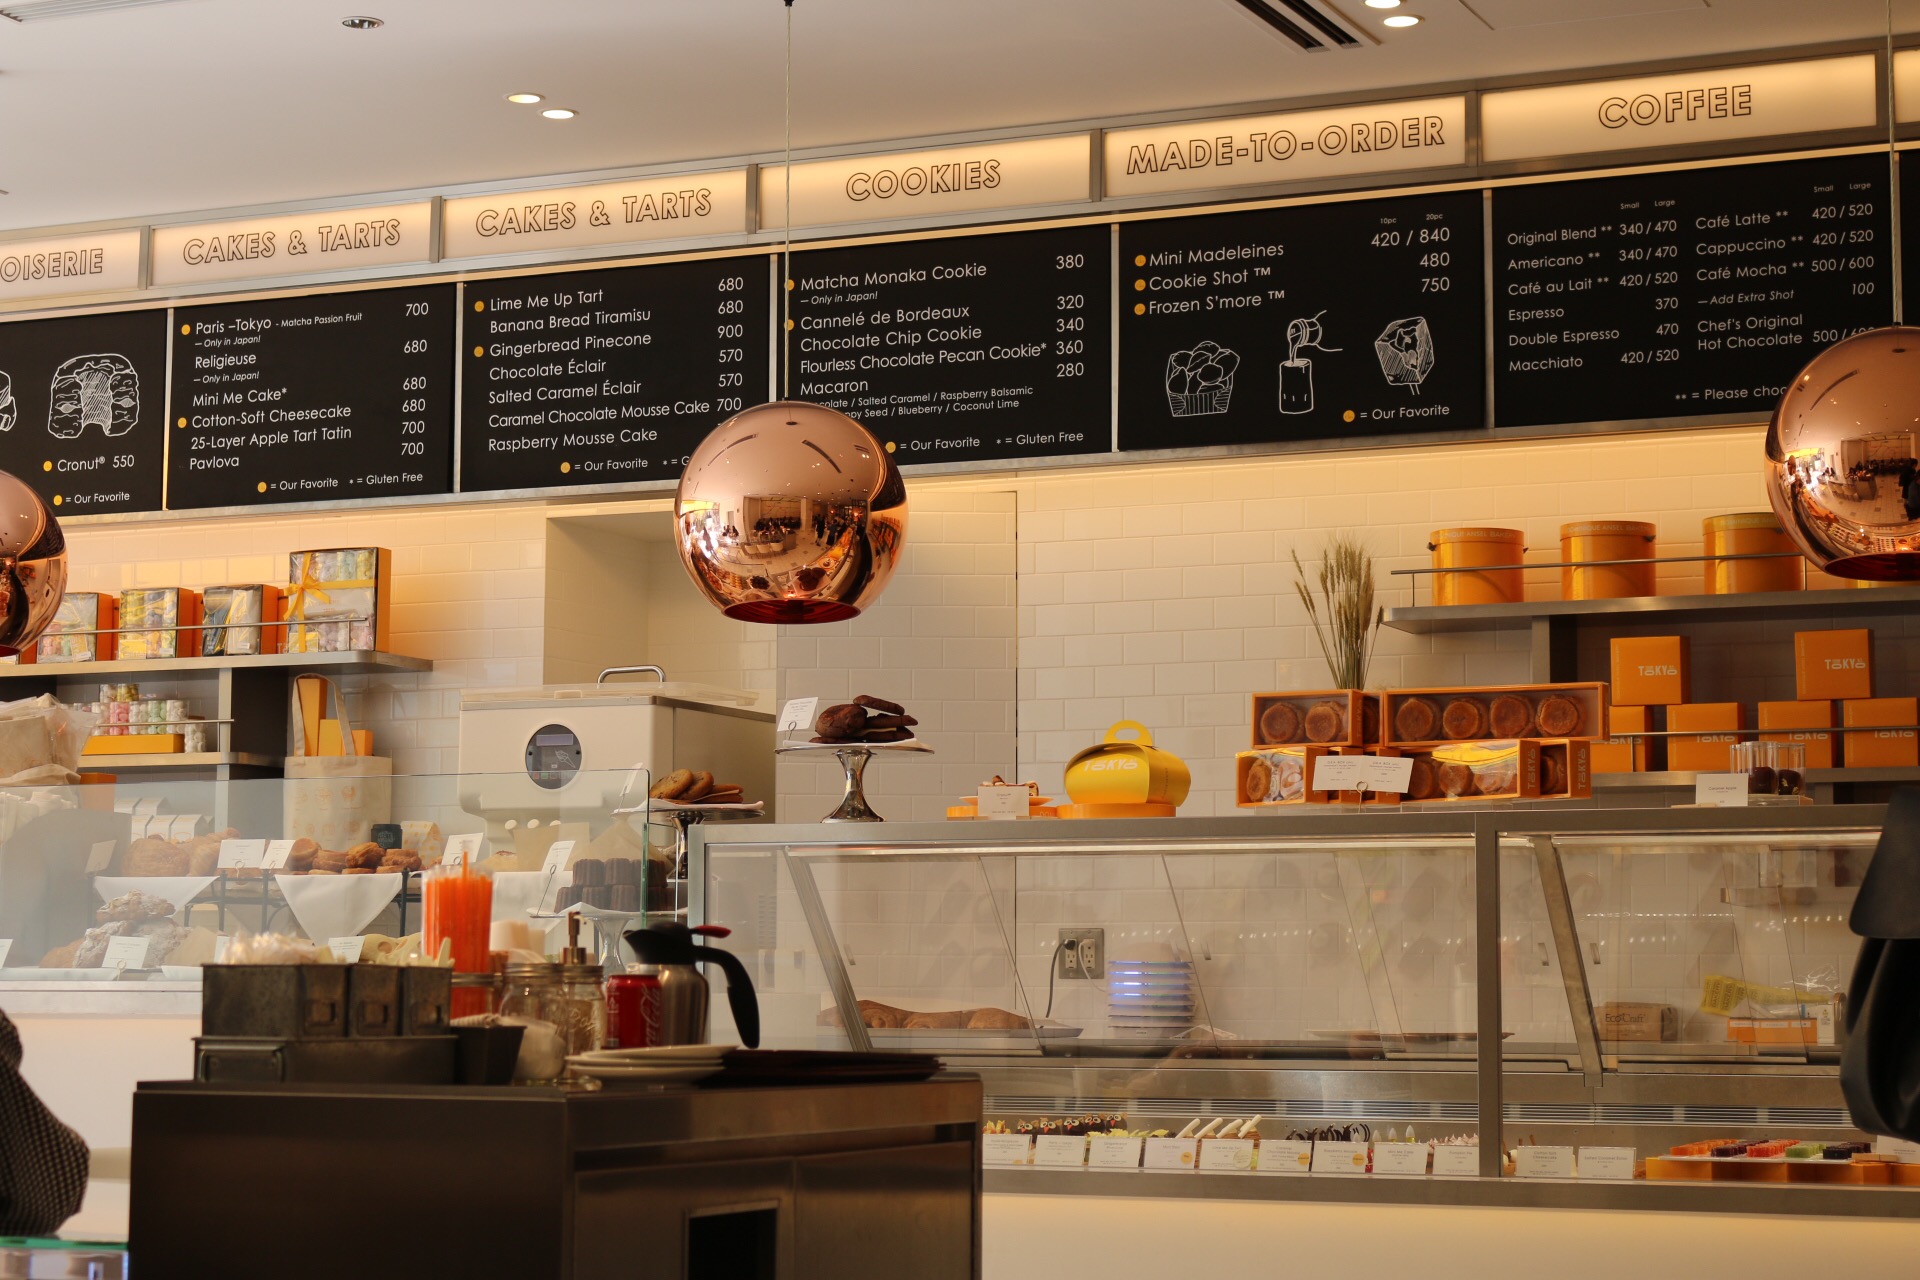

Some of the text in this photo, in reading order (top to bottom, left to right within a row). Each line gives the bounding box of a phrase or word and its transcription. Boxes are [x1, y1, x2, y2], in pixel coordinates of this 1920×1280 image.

[1598, 84, 1752, 129] COFFEE
[1127, 116, 1445, 175] MADE-TO-ORDER
[846, 159, 1001, 201] COOKIES
[1813, 185, 1834, 193] Small
[476, 188, 712, 237] CAKES & TARTS
[1620, 202, 1640, 210] Small
[1695, 213, 1771, 229] Café Latte
[183, 219, 401, 265] CAKES & TARTS
[1371, 227, 1450, 247] 420 840
[1507, 226, 1597, 246] Original Blend
[1149, 243, 1284, 267] Mini Madeleines
[1696, 238, 1786, 256] Cappuccino
[0, 248, 104, 283] OISERIE
[1056, 254, 1084, 270] 380
[1419, 252, 1450, 268] 480
[1508, 255, 1584, 270] Americano
[800, 262, 987, 291] Matcha Monaka Cookie
[1149, 269, 1249, 291] Cookie Shot
[1696, 264, 1787, 281] Café Mocha
[718, 276, 744, 292] 680
[1421, 276, 1450, 293] 750
[1508, 278, 1592, 296] Café au Lait
[1853, 282, 1875, 295] 100
[490, 289, 604, 312] Lime Me Up Tart
[811, 291, 878, 305] Only in Japan!
[1056, 294, 1084, 310] 320
[1149, 295, 1262, 315] Frozen S'more
[1655, 297, 1679, 310] 370
[1710, 289, 1794, 304] Add Extra Shot
[405, 302, 429, 317] 700
[718, 299, 744, 315] 680
[1508, 308, 1565, 322] Espresso
[196, 320, 225, 335] Paris
[281, 317, 312, 327] Matcha
[314, 315, 344, 325] Passion
[345, 312, 363, 322] Fruit
[490, 308, 651, 334] Banana Bread Tiramisu
[800, 306, 970, 330] Cannelé de Bordeaux
[1056, 317, 1084, 333] 340
[1697, 314, 1803, 333] Chef's Original
[717, 324, 743, 339] 900
[1509, 329, 1620, 346] Double Espresso
[1656, 323, 1679, 335] 470
[203, 334, 261, 348] Only in Japan!
[403, 339, 428, 354] 680
[489, 334, 652, 358] Gingerbread Pinecone
[800, 325, 982, 352] Chocolate Chip Cookie
[1056, 339, 1084, 355] 360
[1698, 333, 1803, 350] Hot Chocolate
[195, 353, 257, 370] Religieuse
[718, 348, 743, 363] 570
[800, 358, 856, 374] Flourless
[859, 351, 935, 369] Chocolate
[939, 350, 985, 364] Pecan
[1509, 356, 1583, 372] Macchiato
[489, 358, 607, 381] Chocolate Éclair
[1056, 362, 1084, 378] 280
[402, 376, 427, 391] 680
[718, 372, 743, 388] 570
[800, 380, 868, 396] Macaron
[192, 392, 219, 407] Mini
[222, 392, 243, 405] Me
[488, 379, 642, 404] Salted Caramel Éclair
[858, 387, 1033, 407] Salted Caramel Raspberry Balsamic
[1705, 389, 1748, 400] Please
[402, 398, 426, 413] 680
[717, 397, 742, 412] 700
[864, 399, 1020, 418] Seed Blueberry Coconut Lime
[192, 405, 352, 429] Cotton-Soft Cheesecake
[488, 400, 710, 428] Caramel Chocolate Mousse Cake
[402, 420, 425, 435] 700
[191, 426, 352, 450] 25-Layer Apple Tart Tatin
[488, 428, 658, 453] Raspberry Mousse Cake
[910, 431, 1084, 451] Our Favorite Gluten Free
[401, 441, 424, 456] 700
[112, 454, 135, 469] 550
[189, 455, 240, 470] Pavlova
[584, 458, 649, 472] Our Favorite
[279, 472, 423, 491] Our Favorite Gluten Free
